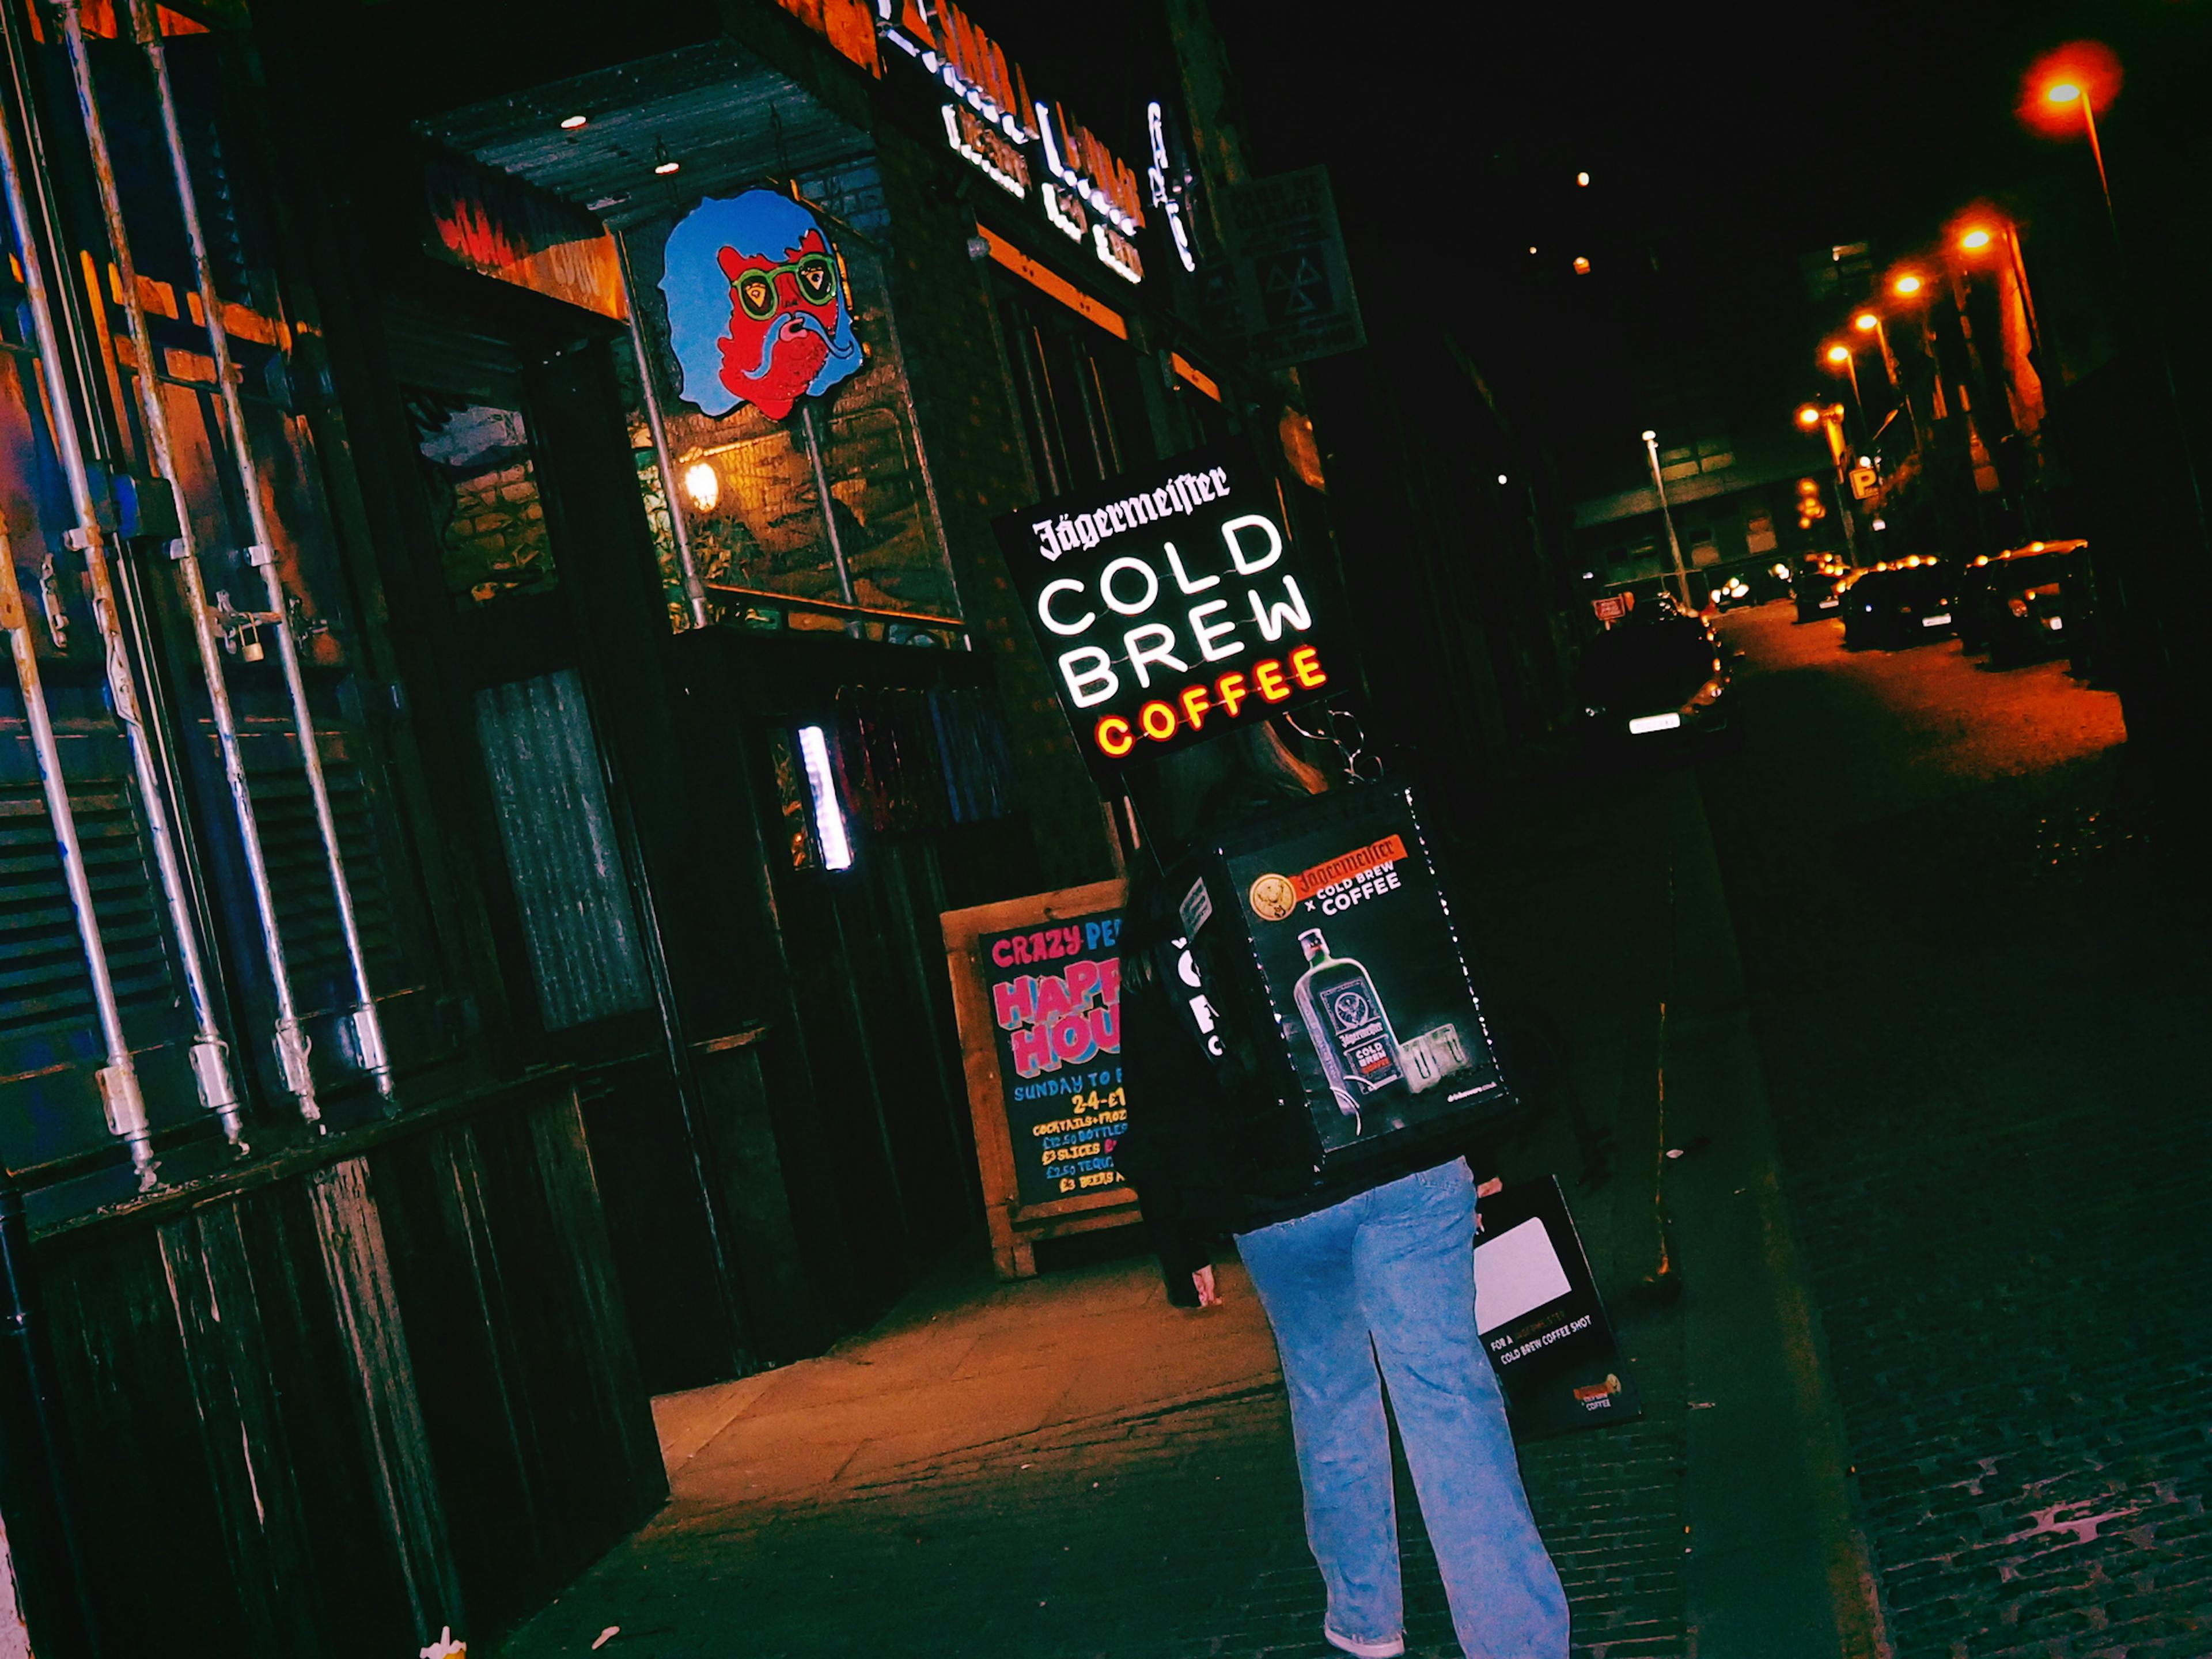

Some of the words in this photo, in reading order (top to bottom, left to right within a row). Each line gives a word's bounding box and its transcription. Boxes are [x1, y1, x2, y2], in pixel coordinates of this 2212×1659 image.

[1853, 470, 1877, 497] P
[1032, 466, 1230, 562] Jägermeister
[1037, 514, 1282, 635] COLD
[1058, 574, 1312, 708] BREW
[1096, 645, 1327, 757] COFFEE
[1316, 878, 1352, 900] COLD
[1355, 861, 1395, 883] BREW
[1321, 872, 1402, 916] COFFEE
[992, 925, 1084, 968] CRAZY
[1355, 1041, 1382, 1060] COLD
[1014, 1075, 1083, 1101] SUNDAY
[1088, 1071, 1111, 1087] TO
[1057, 1142, 1101, 1161] SLICES
[1078, 1171, 1114, 1188] BEERS
[1490, 1339, 1508, 1352] FOR
[1506, 1335, 1513, 1344] A
[1500, 1347, 1521, 1365] COLD
[1520, 1338, 1543, 1356] BREW
[1541, 1325, 1571, 1346] COFFEE
[1570, 1314, 1593, 1333] SHOT
